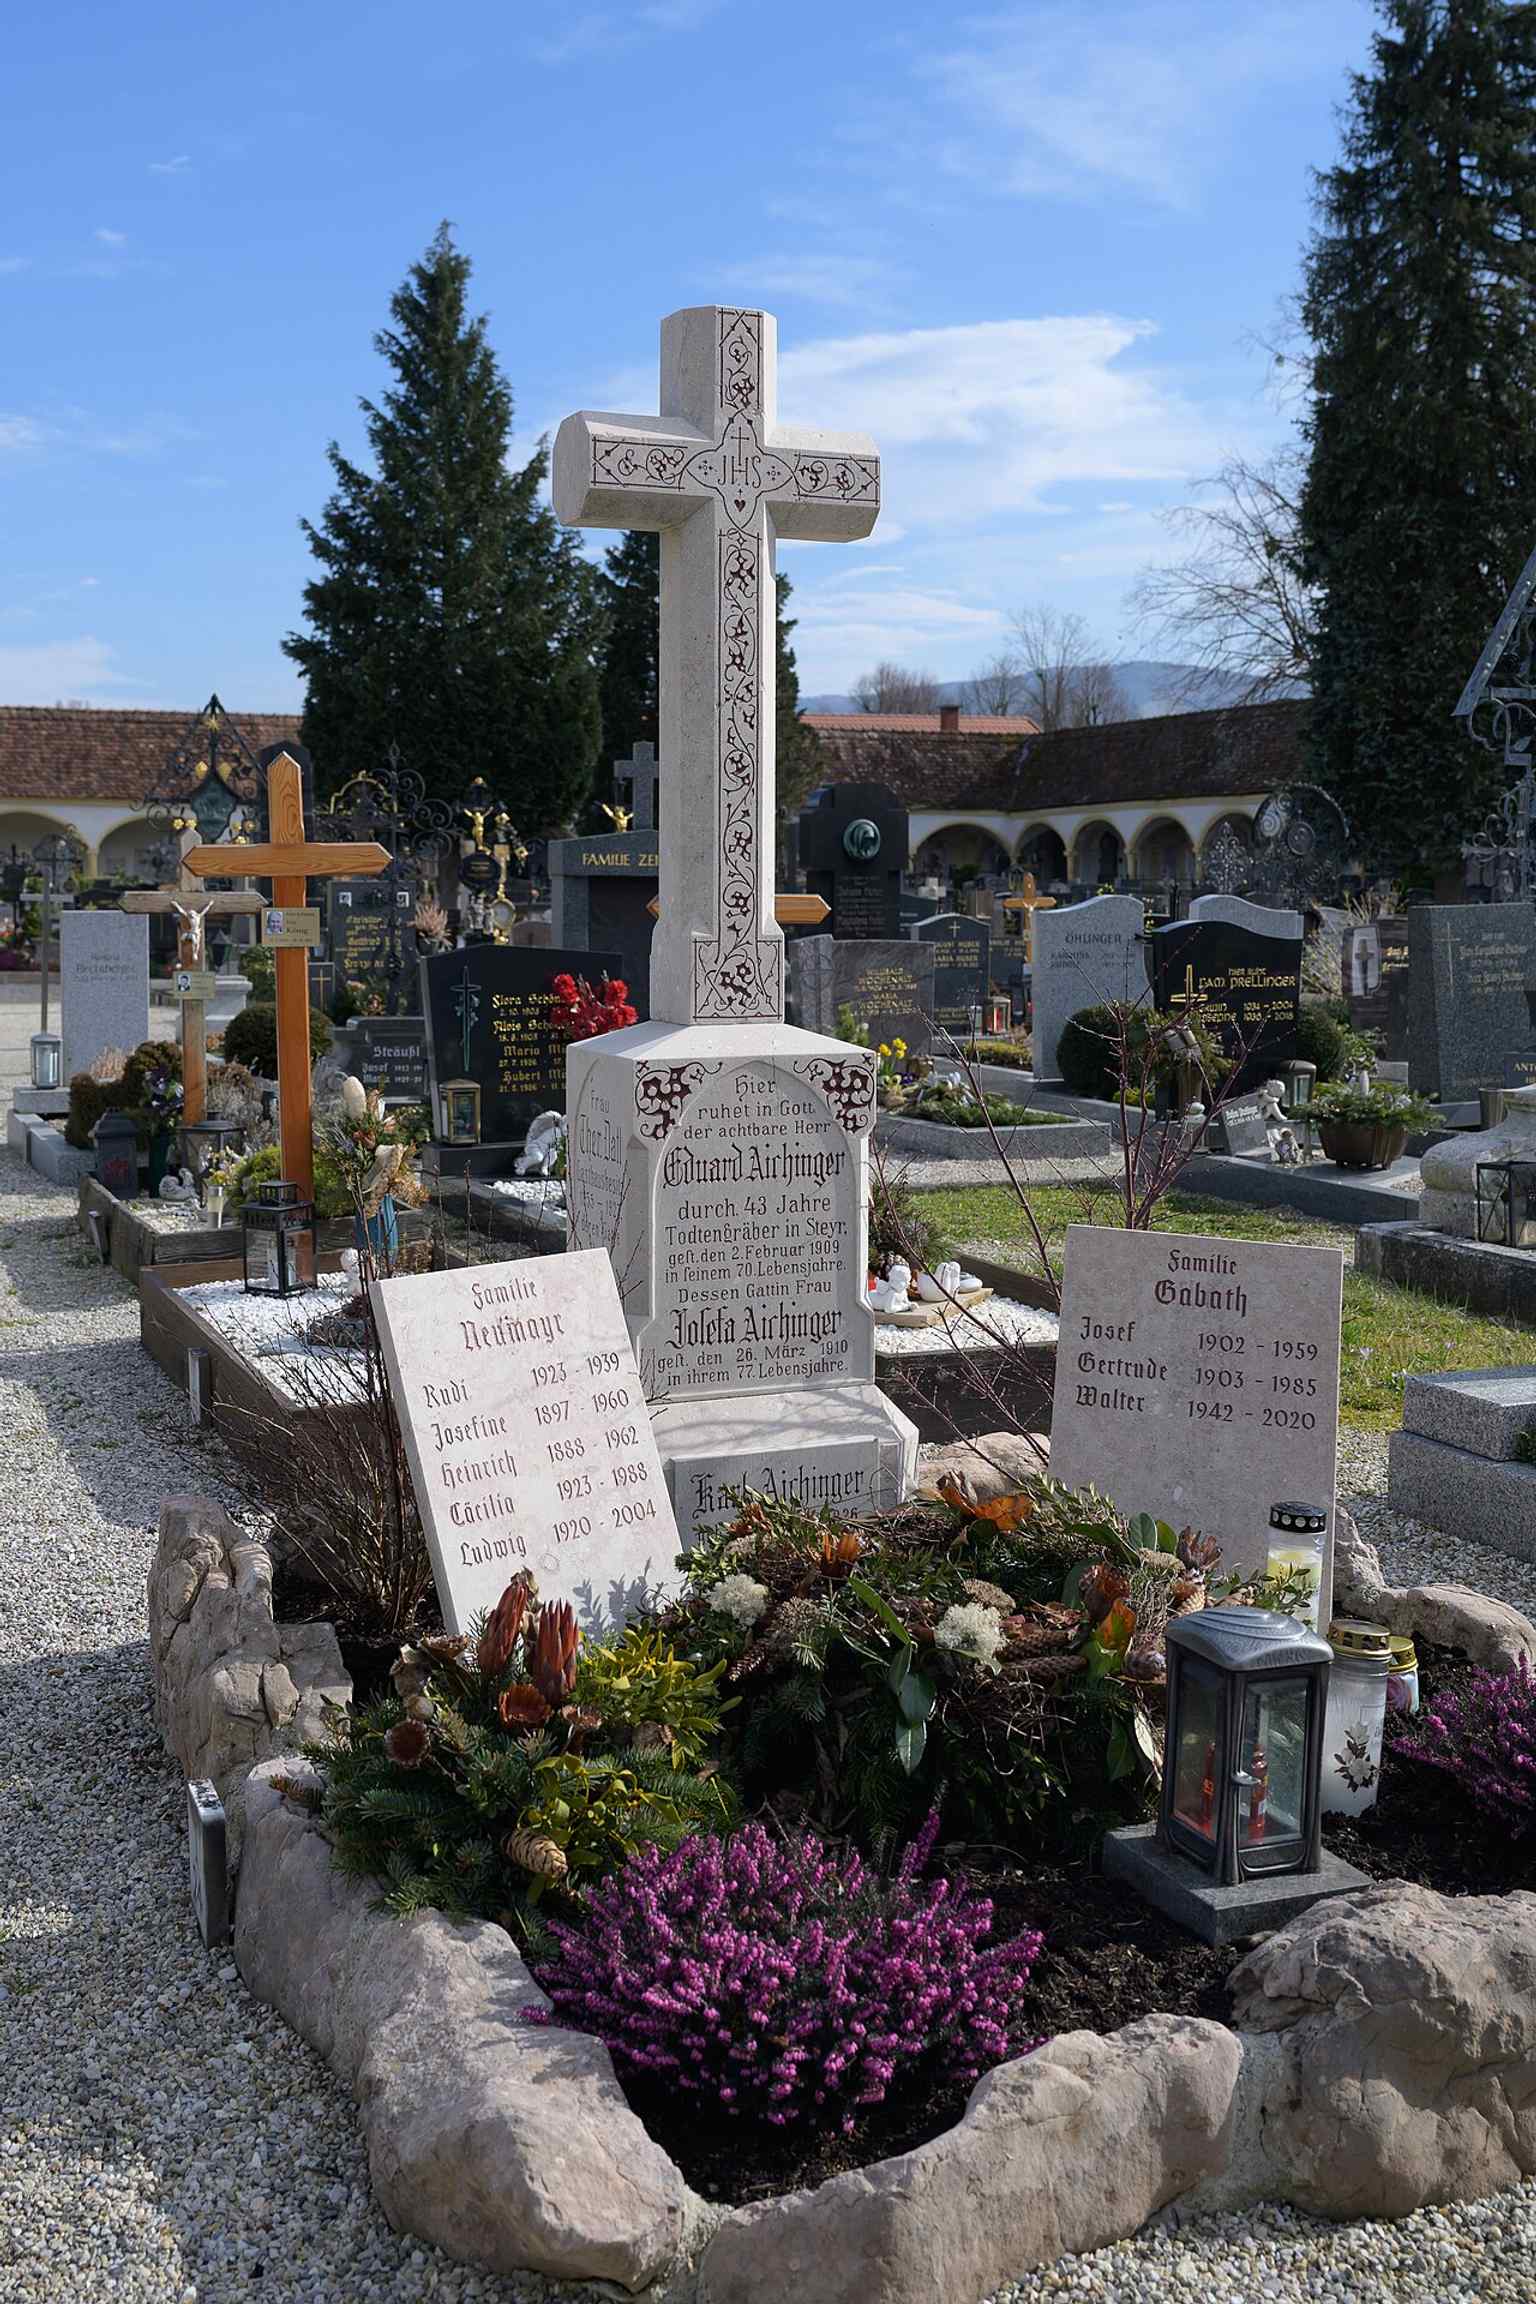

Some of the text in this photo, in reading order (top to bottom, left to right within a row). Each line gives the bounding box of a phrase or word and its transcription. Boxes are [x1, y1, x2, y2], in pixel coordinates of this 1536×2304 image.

[698, 1103, 750, 1120] ruhet
[757, 1102, 772, 1117] in
[684, 1120, 832, 1139] der achtbare Herr
[663, 1142, 743, 1188] Eduard
[744, 1142, 846, 1188] Aichinger
[744, 1196, 767, 1215] 43
[776, 1193, 831, 1214] Jahre
[665, 1222, 780, 1245] Todtengräber
[785, 1218, 800, 1238] in
[810, 1240, 840, 1255] 1909
[665, 1270, 678, 1284] in
[1167, 1249, 1238, 1276] Familie
[471, 1277, 537, 1311] Familie
[679, 1279, 832, 1304] Dessen Gattin Frau
[739, 1301, 842, 1344] Aichinger
[1080, 1316, 1136, 1343] Josef
[1198, 1332, 1245, 1355] 1902
[1273, 1340, 1318, 1361] 1959
[697, 1351, 722, 1366] den
[765, 1345, 806, 1360] März
[820, 1339, 848, 1355] 1910
[423, 1379, 470, 1408] Rudi
[530, 1362, 567, 1387] 1923
[586, 1351, 620, 1377] 1939
[667, 1372, 680, 1386] in
[687, 1368, 730, 1385] ihrem
[1078, 1351, 1168, 1382] Gertrude
[1195, 1367, 1244, 1389] 1903
[1272, 1375, 1317, 1397] 1985
[431, 1414, 507, 1451] Josefine
[535, 1400, 570, 1425] 1897
[591, 1388, 629, 1414] 1960
[1076, 1384, 1145, 1413] Walter
[1188, 1400, 1233, 1423] 1942
[1262, 1408, 1316, 1430] 2020
[441, 1449, 518, 1489] Heinrich
[546, 1437, 586, 1464] 1888
[604, 1425, 640, 1450] 1962
[556, 1475, 592, 1502] 1923
[611, 1461, 648, 1489] 1988
[460, 1532, 528, 1567] Ludwig
[552, 1516, 592, 1544] 1920
[611, 1499, 657, 1529] 2004
